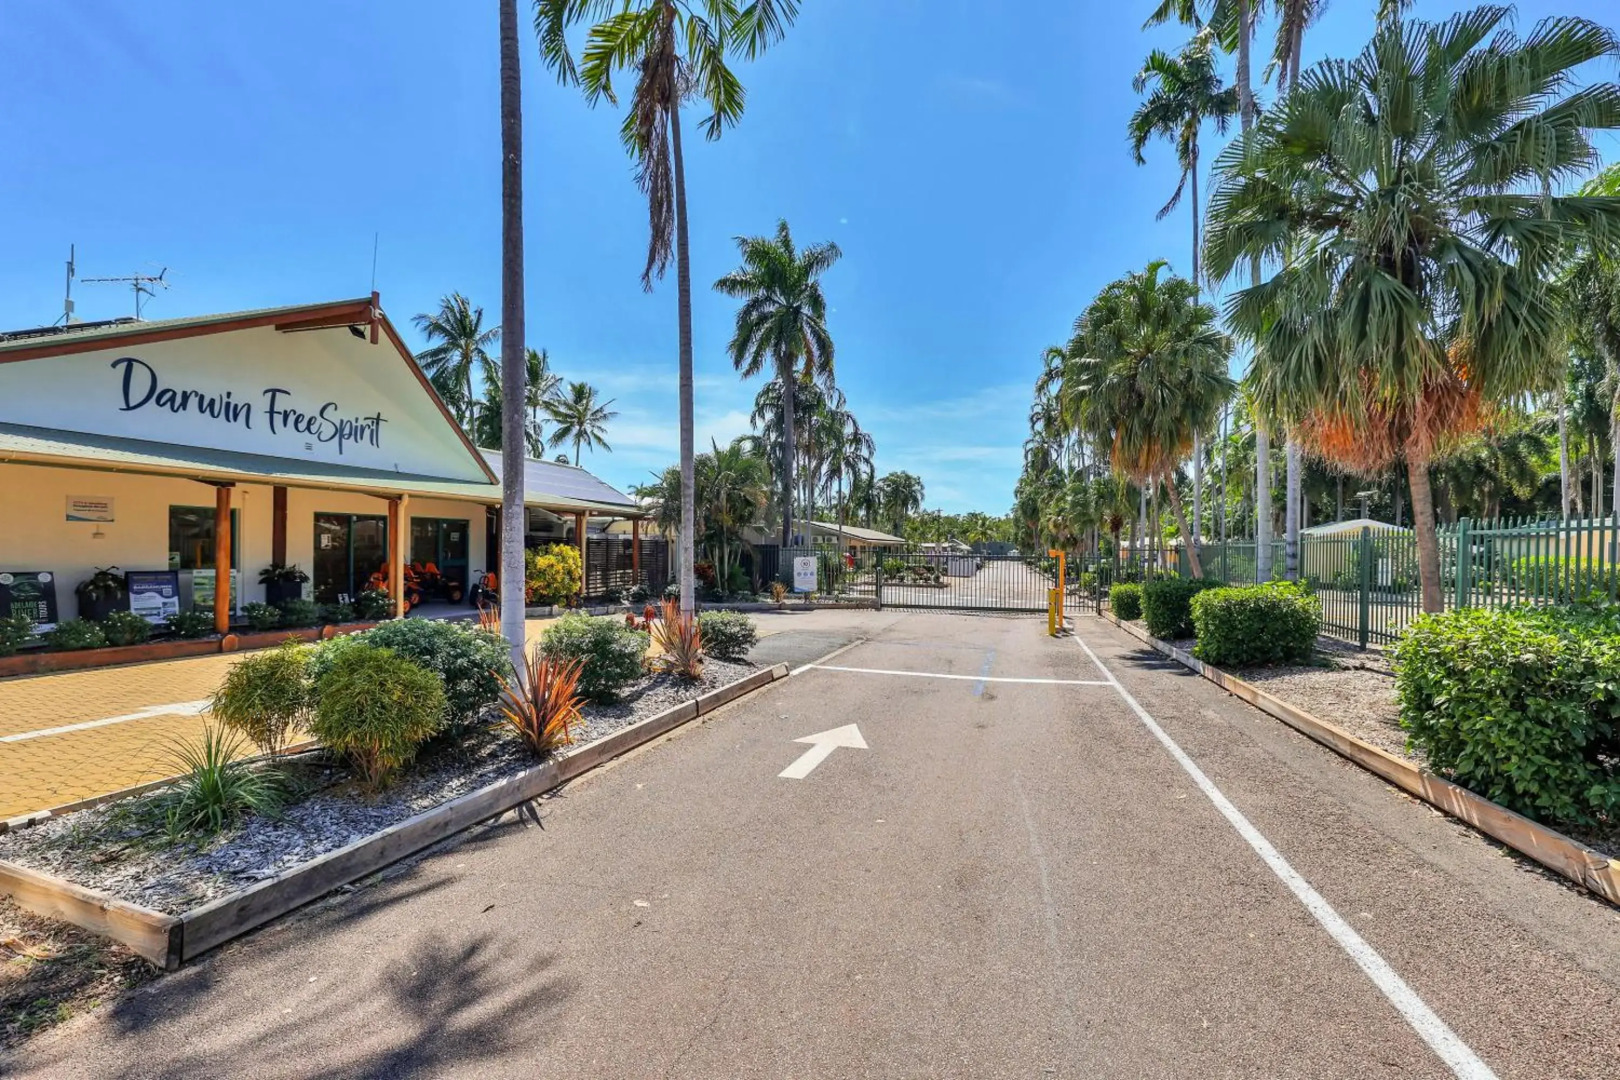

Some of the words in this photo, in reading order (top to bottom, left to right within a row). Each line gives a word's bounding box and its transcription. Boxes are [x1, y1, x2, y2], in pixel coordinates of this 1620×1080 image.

[111, 357, 252, 429] Darwin
[263, 388, 388, 455] FreeSpirit
[12, 608, 38, 619] RIVER
[37, 600, 48, 618] TOURS
